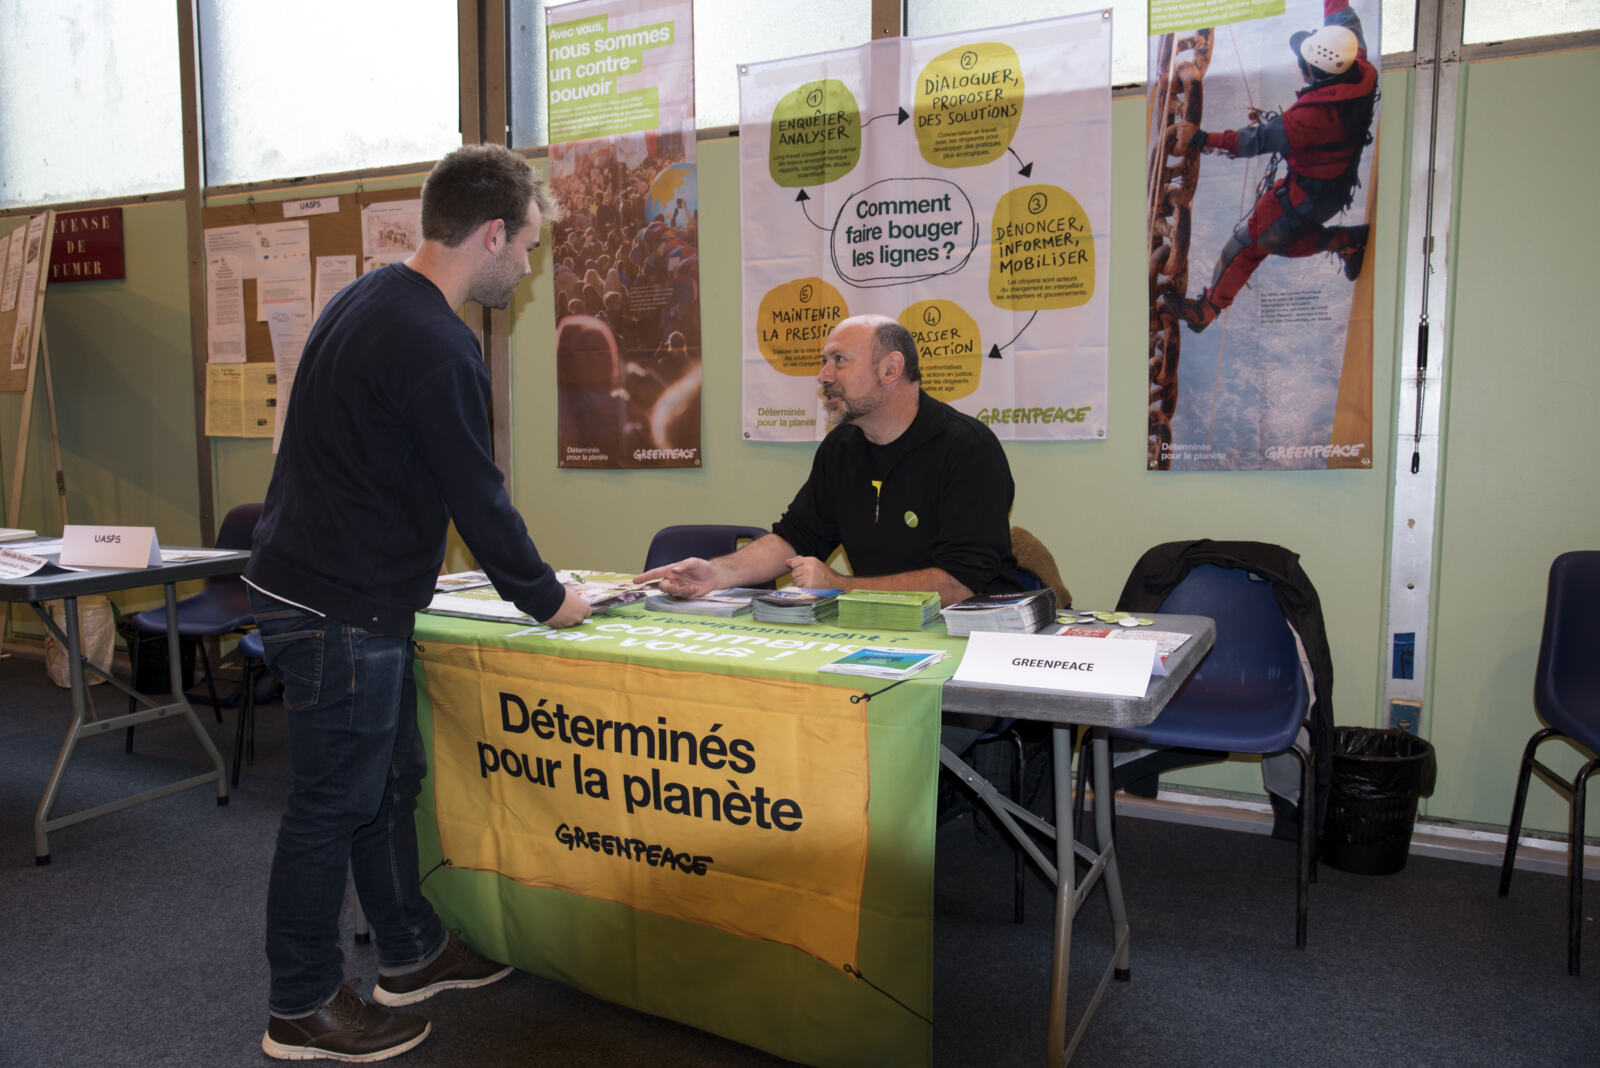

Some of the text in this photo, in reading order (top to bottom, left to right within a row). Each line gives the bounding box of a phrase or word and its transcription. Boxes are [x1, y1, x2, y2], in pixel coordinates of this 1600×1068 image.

[549, 23, 605, 41] Avec vous,
[549, 26, 670, 61] nous sommes
[550, 55, 638, 82] un contre-
[550, 78, 613, 104] pouvoir
[933, 88, 1004, 111] PROPOSER
[918, 113, 942, 128] DES
[779, 125, 850, 146] ANALYSER
[856, 193, 952, 219] Comment
[55, 215, 110, 233] FENSE
[845, 220, 963, 244] faire bouger
[996, 217, 1084, 241] DÉNONCER,
[66, 240, 86, 254] DE
[852, 248, 875, 268] les
[53, 261, 102, 278] FUMER
[762, 329, 779, 342] LA
[757, 407, 806, 417] Déterminés
[975, 406, 1092, 426] GREENPEACE
[757, 418, 777, 429] pour
[779, 417, 787, 427] la
[633, 448, 697, 461] GREENPEACE
[1161, 452, 1183, 461] pour
[1183, 451, 1192, 460] la
[1264, 443, 1365, 460] GREENPEACE
[94, 534, 121, 544] UASPS
[504, 627, 616, 641] par
[618, 637, 756, 657] vous
[595, 623, 863, 654] commenc
[1012, 657, 1095, 672] GREENPEACE
[499, 692, 756, 775] Déterminés
[477, 740, 803, 832] pour la planète
[555, 823, 714, 877] GREENPEACE
